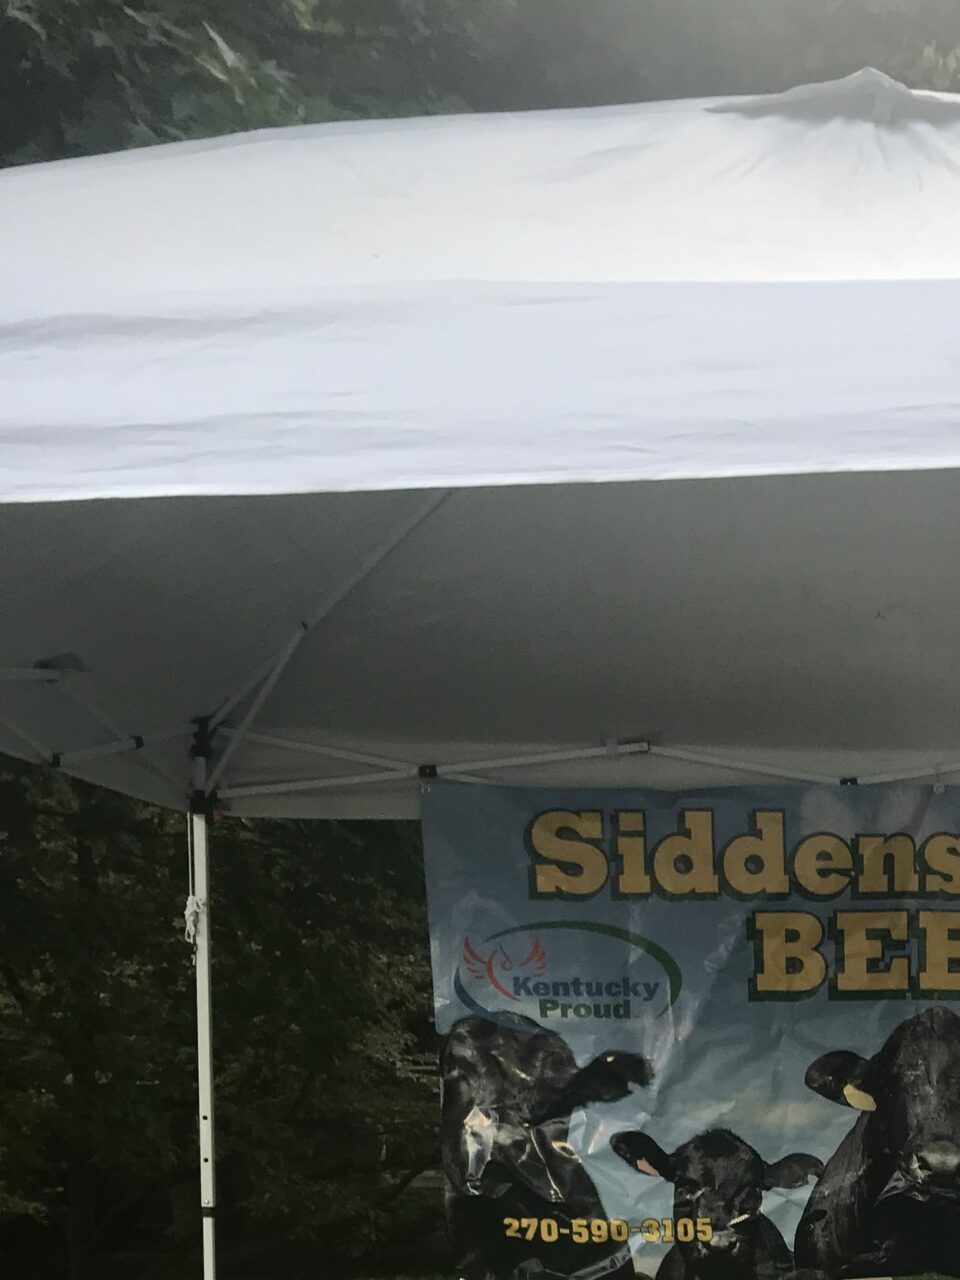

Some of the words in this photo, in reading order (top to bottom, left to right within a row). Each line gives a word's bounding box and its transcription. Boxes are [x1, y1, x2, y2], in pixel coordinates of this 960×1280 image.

[512, 976, 660, 1002] Kentucky
[538, 999, 631, 1019] Proud
[503, 1217, 713, 1244] 270-590-3105
